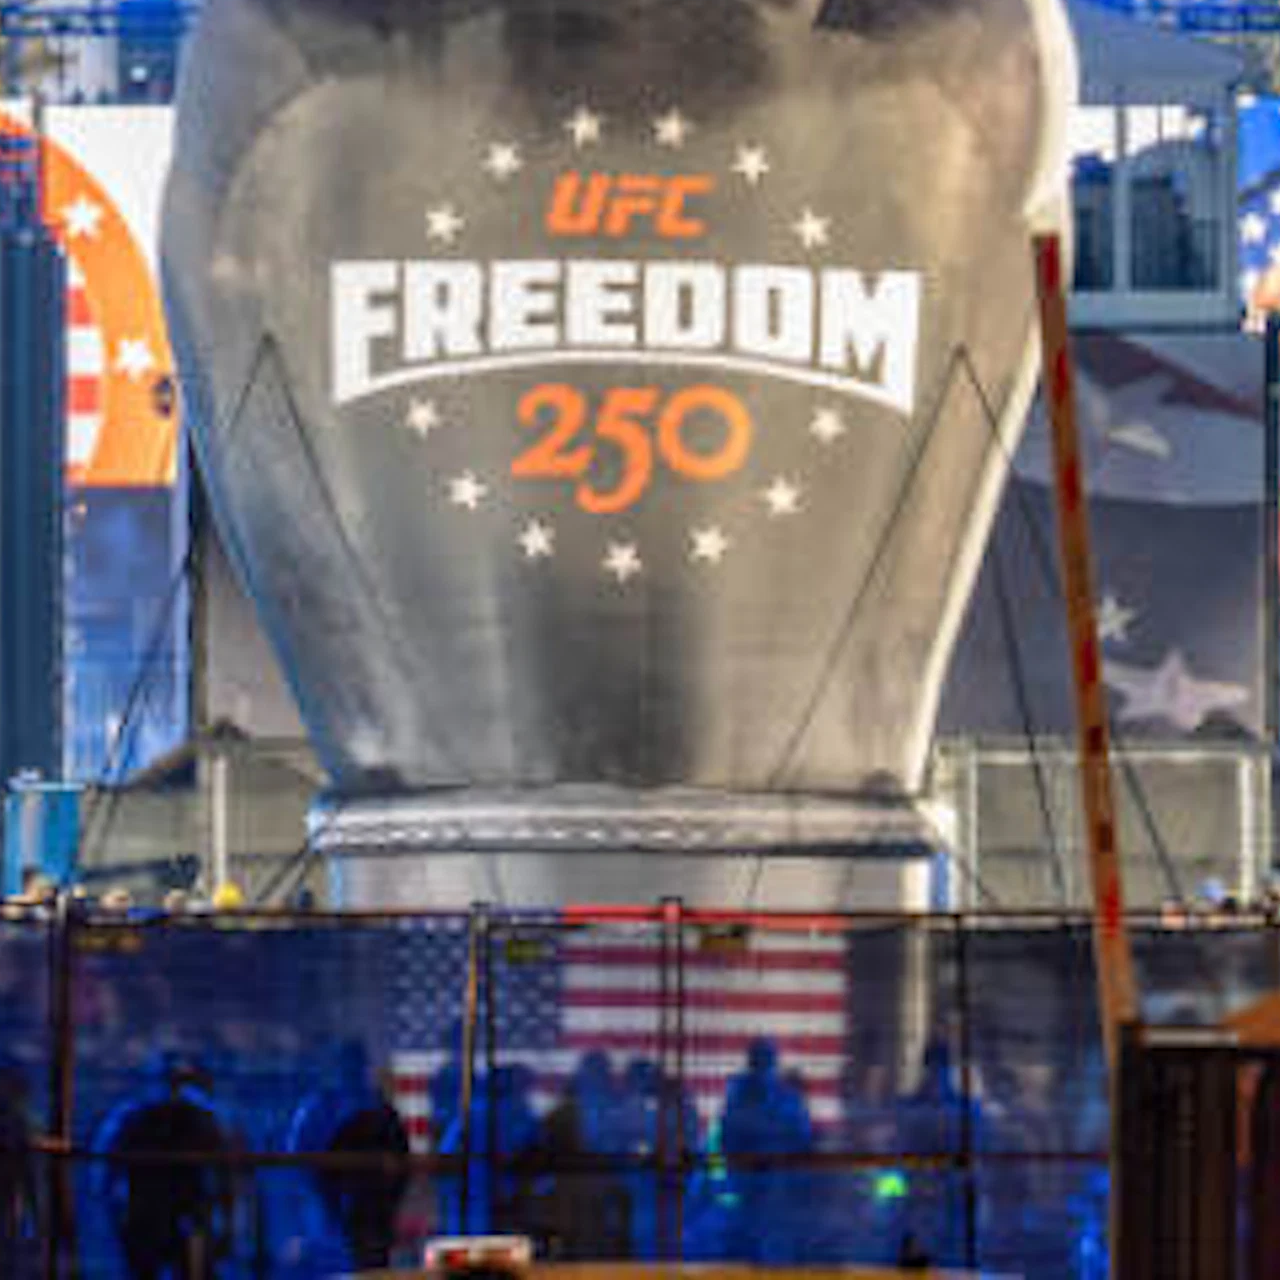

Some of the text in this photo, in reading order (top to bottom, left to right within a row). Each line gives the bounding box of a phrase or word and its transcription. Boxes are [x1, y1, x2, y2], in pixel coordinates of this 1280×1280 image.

[545, 171, 714, 236] UFC
[330, 259, 922, 417] FREEDOM
[511, 382, 752, 513] 250
